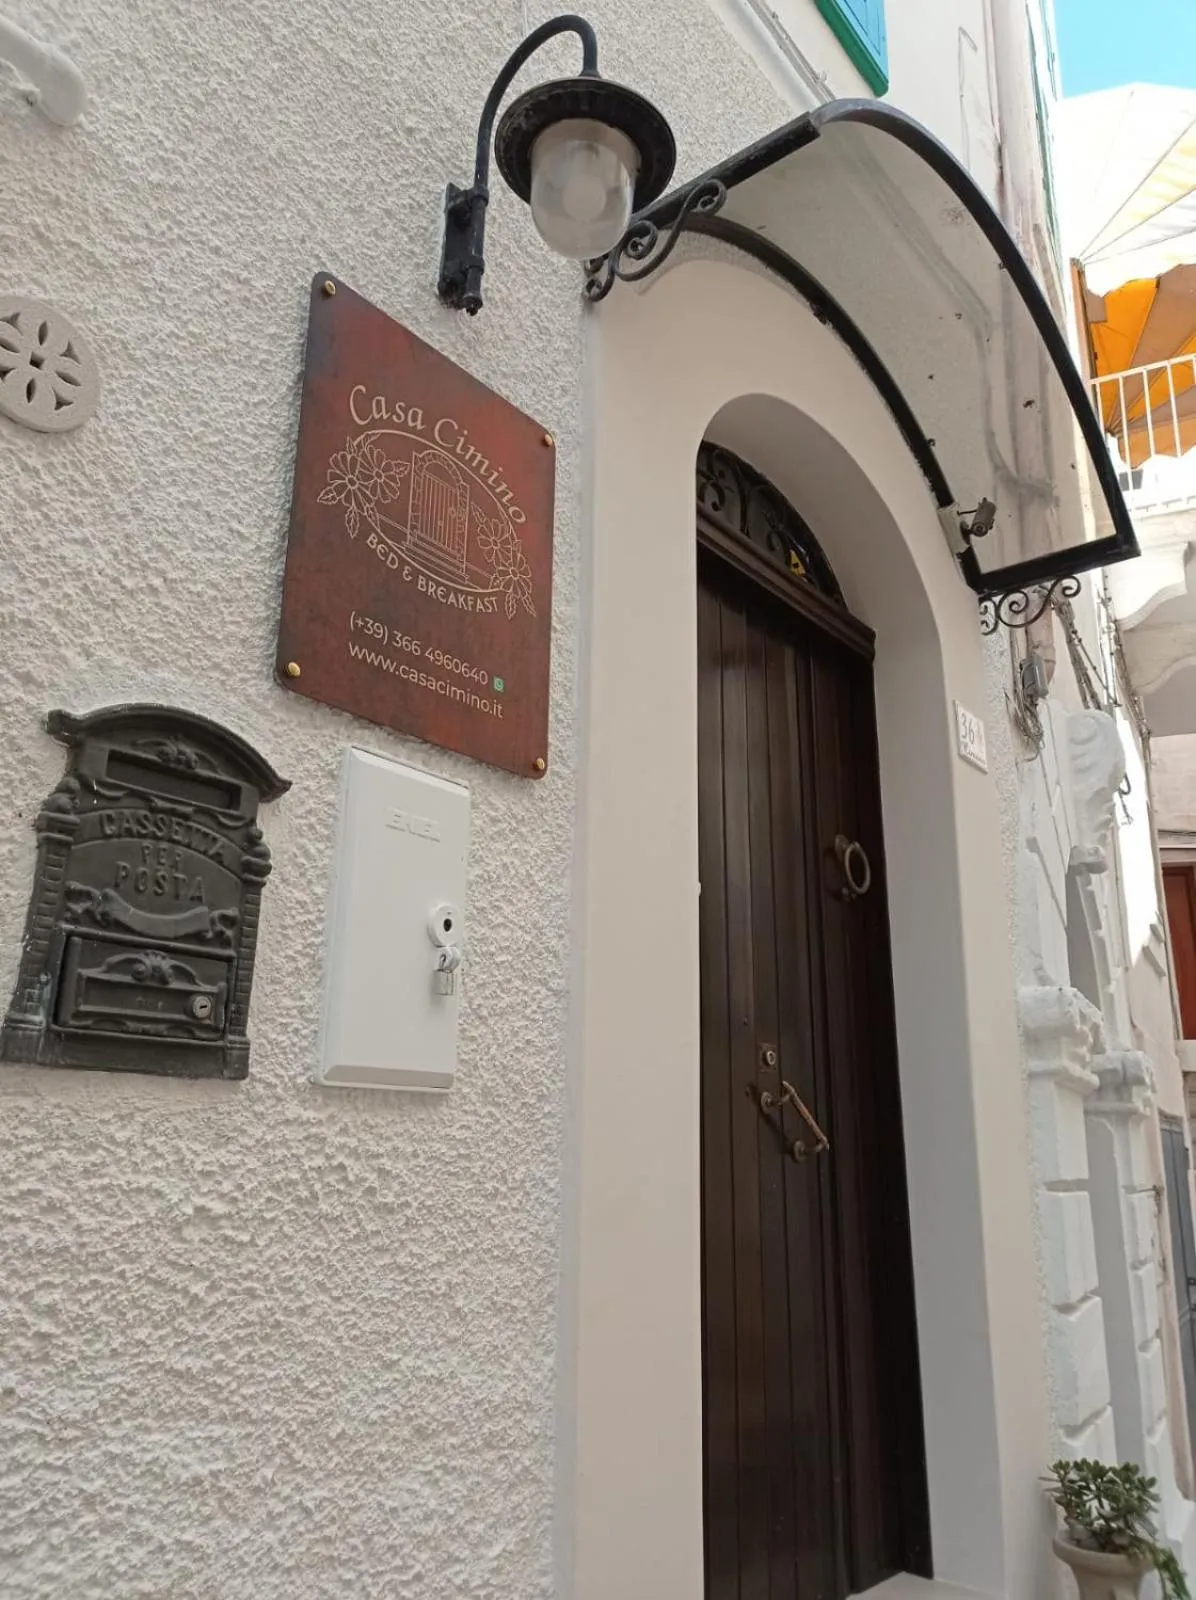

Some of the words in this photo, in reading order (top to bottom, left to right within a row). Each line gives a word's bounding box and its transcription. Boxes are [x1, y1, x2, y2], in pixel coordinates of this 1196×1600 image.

[350, 384, 426, 430] Casa
[434, 418, 527, 524] Cimino
[366, 533, 399, 570] BED
[402, 565, 413, 582] &
[416, 575, 499, 614] BREAKFAST
[348, 641, 504, 719] www.casacimino.it
[350, 610, 389, 645] (+39)
[391, 630, 422, 656] 366
[424, 647, 489, 686] 4960640
[101, 809, 225, 865] CASSETTA
[141, 842, 184, 872] PER
[114, 860, 204, 904] POSTA
